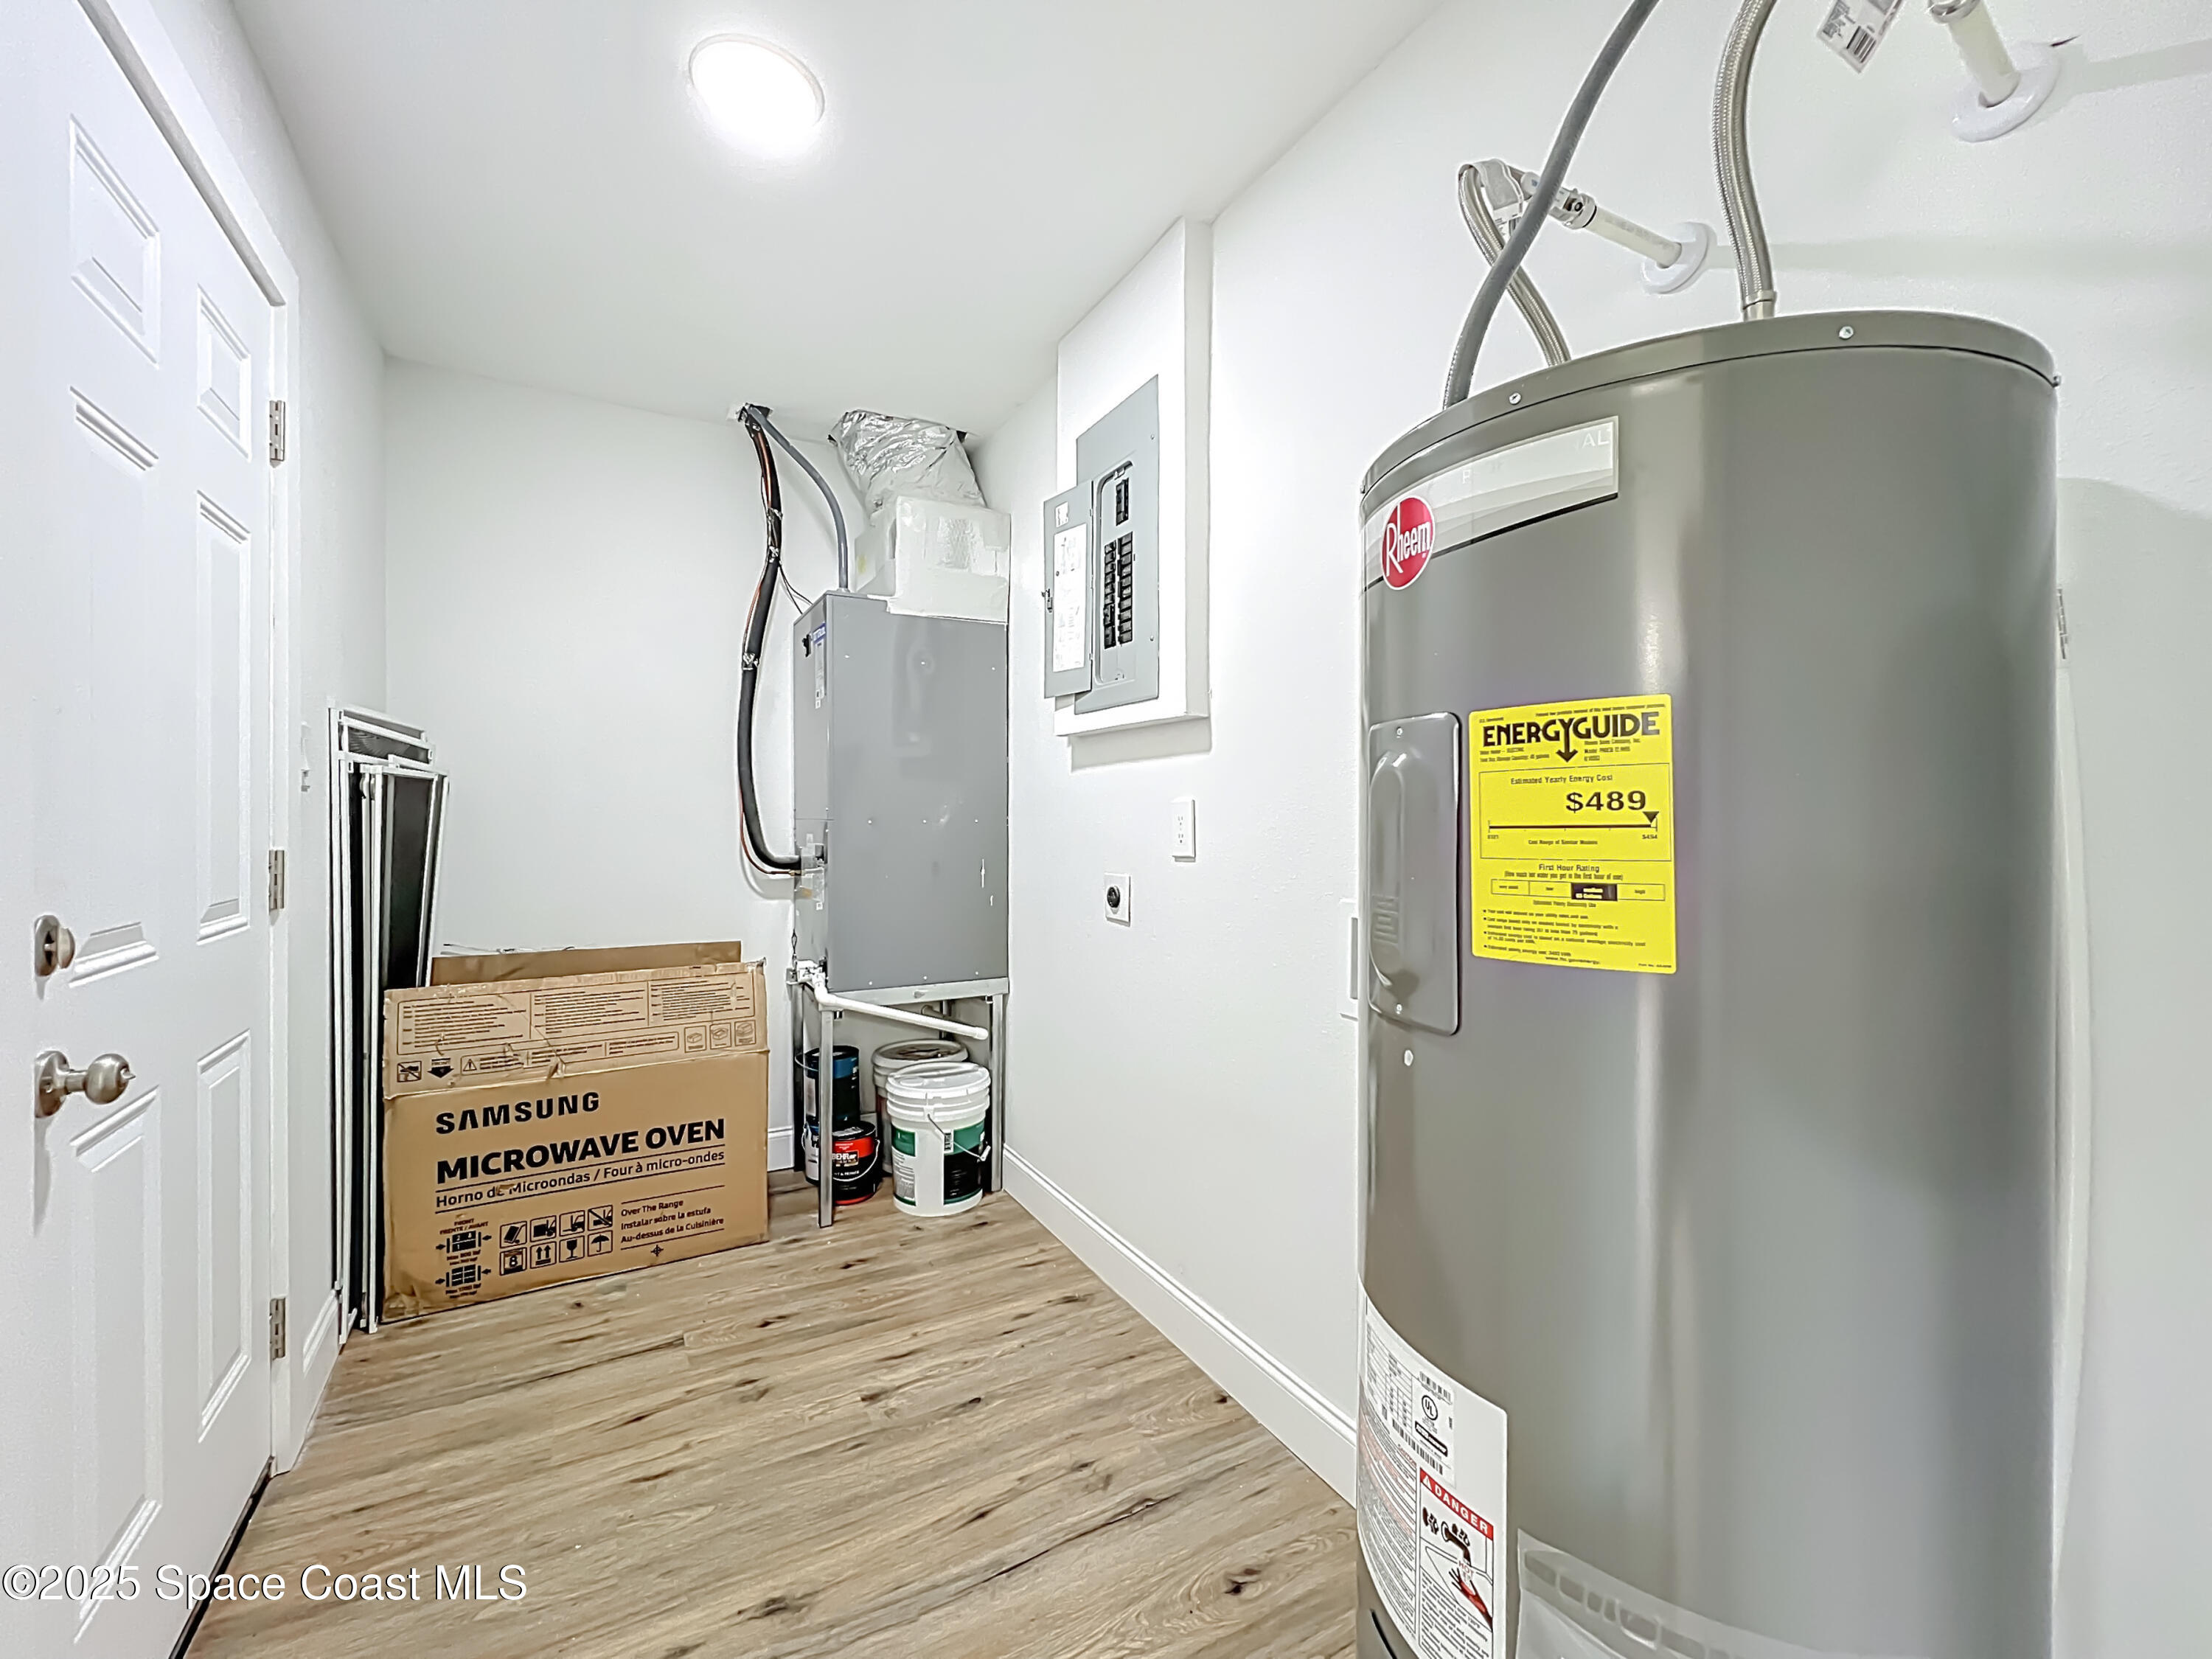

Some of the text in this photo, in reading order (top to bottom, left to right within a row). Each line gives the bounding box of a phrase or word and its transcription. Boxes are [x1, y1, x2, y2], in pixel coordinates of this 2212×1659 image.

[1386, 501, 1431, 577] Rheem
[1483, 711, 1660, 748] ENERGYGUIDE
[1545, 776, 1567, 785] Yearly
[1569, 774, 1594, 783] Energy
[1565, 790, 1646, 814] $489
[1576, 864, 1600, 874] Rating
[436, 1091, 599, 1135] SAMSUNG
[437, 1118, 725, 1185] MICROWAVE OVEN
[436, 1189, 484, 1208] Horno
[603, 1165, 633, 1179] Four
[635, 1161, 643, 1174] à
[646, 1151, 725, 1172] micro-ondes
[621, 1200, 684, 1217] Over The Range
[621, 1217, 653, 1231] Instalar
[654, 1214, 676, 1224] sobre
[686, 1207, 712, 1218] estufa
[621, 1218, 725, 1244] Au-dessus de la Cuisinière
[1434, 1483, 1489, 1535] DANGER
[1458, 1559, 1475, 1576] HOT
